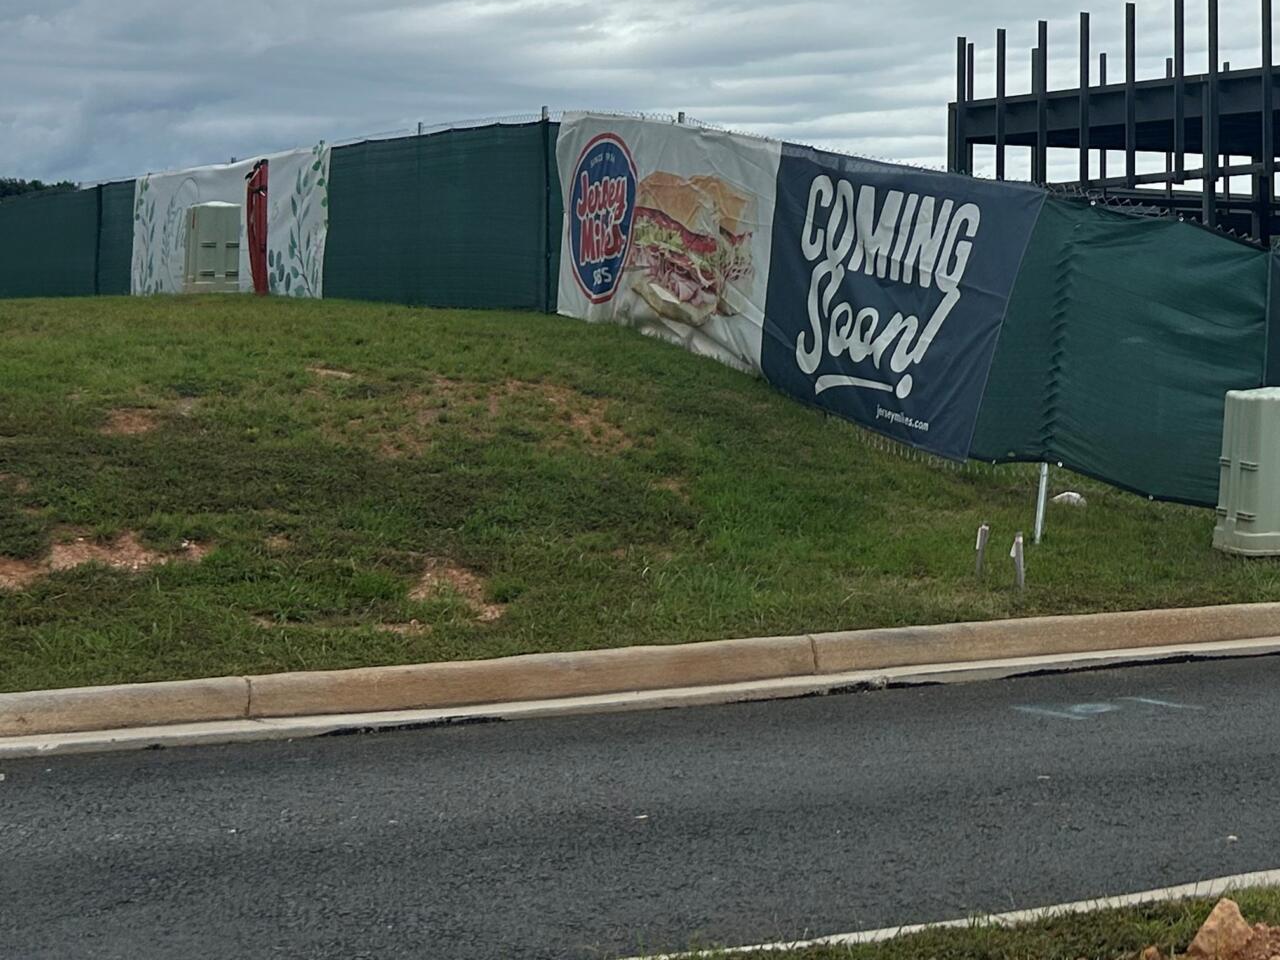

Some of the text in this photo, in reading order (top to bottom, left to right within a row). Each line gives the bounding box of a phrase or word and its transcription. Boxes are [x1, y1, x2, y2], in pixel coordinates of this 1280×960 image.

[576, 170, 628, 224] Jersey
[801, 174, 981, 292] COMING
[796, 259, 961, 399] Soon!
